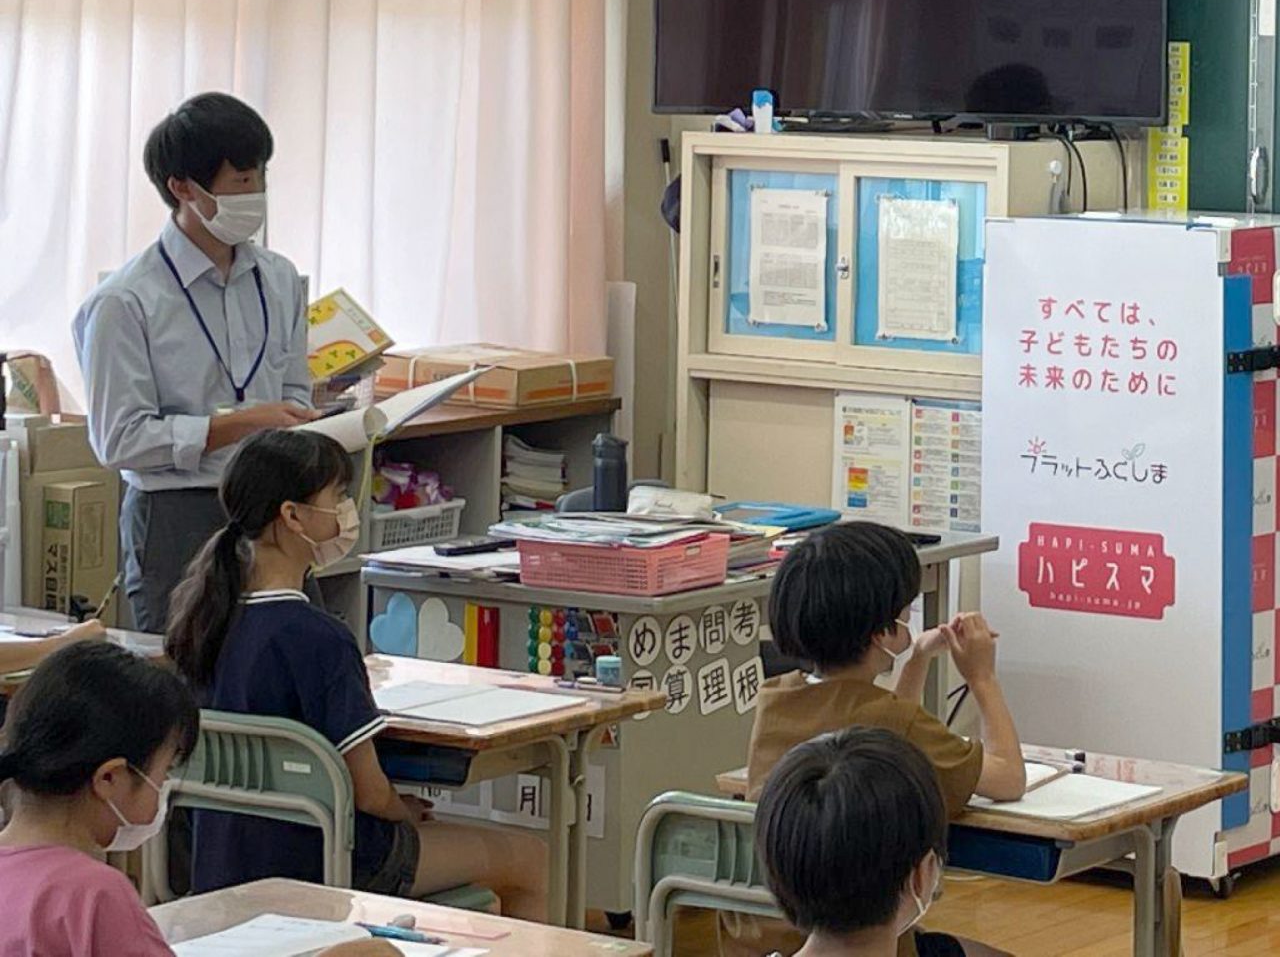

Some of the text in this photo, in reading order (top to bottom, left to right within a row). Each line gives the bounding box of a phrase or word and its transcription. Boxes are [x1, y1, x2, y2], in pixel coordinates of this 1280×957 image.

[1018, 329, 1178, 362] 子どもたちの
[1018, 362, 1177, 396] 未来のために
[1037, 534, 1156, 559] HAPI-SUMA
[1037, 555, 1155, 595] ハピスマ
